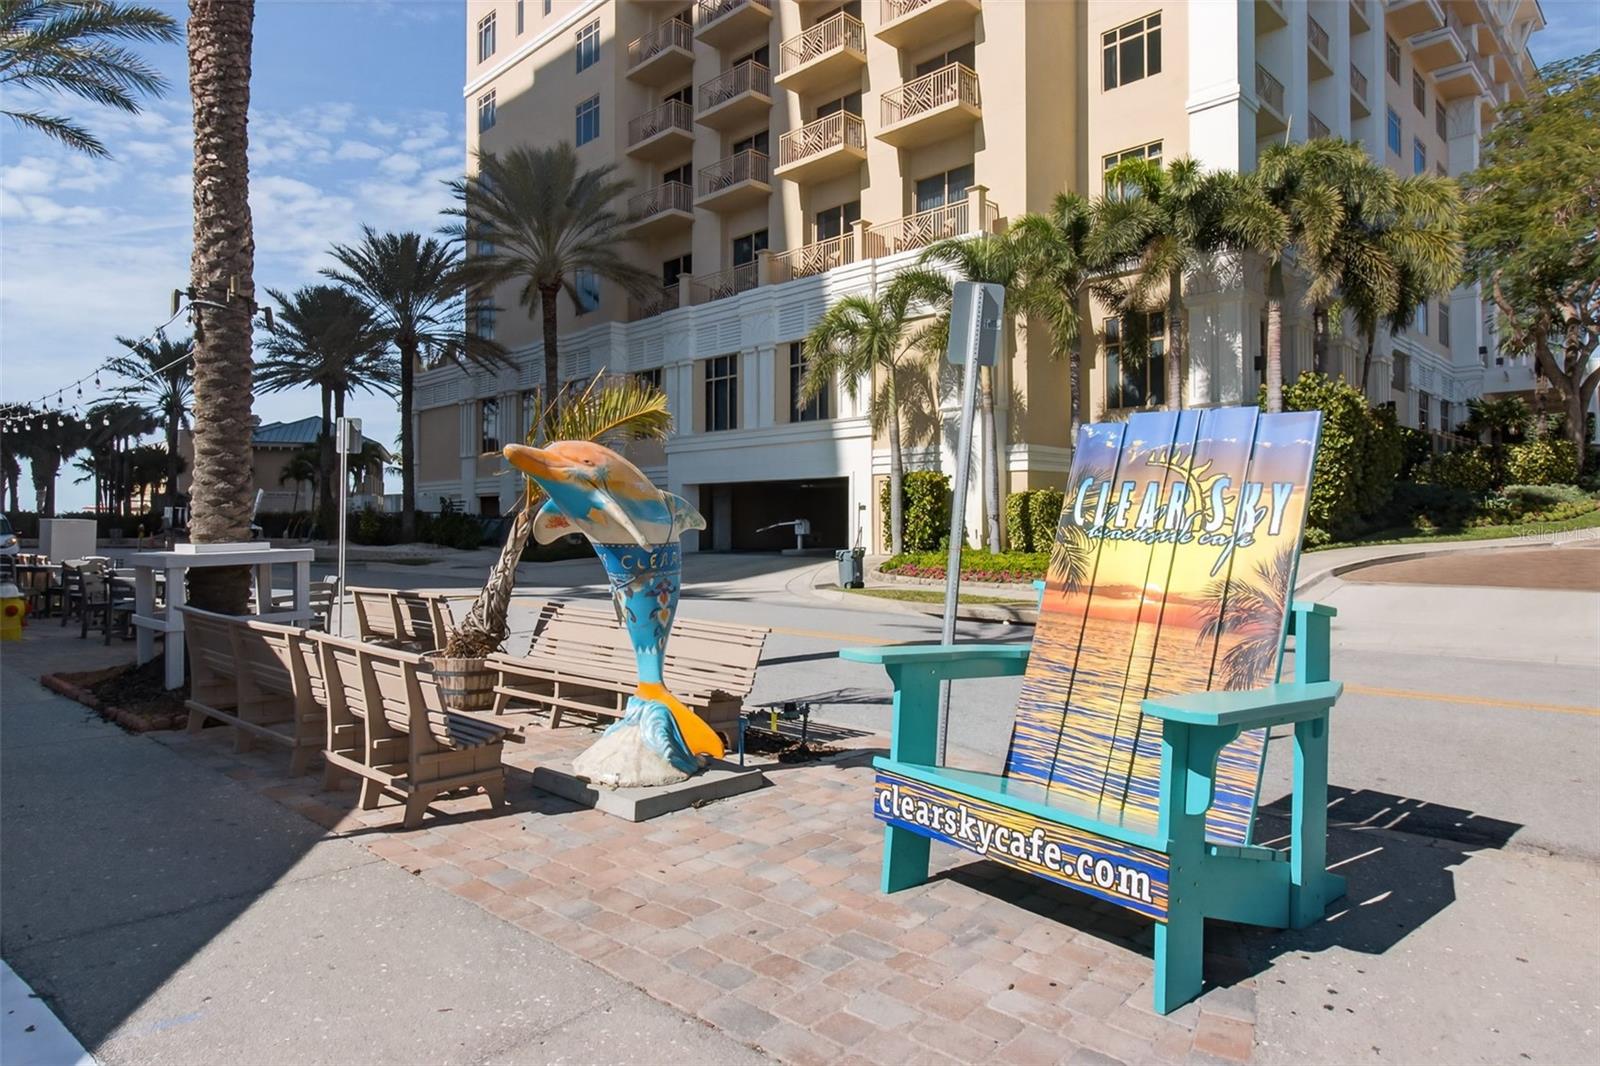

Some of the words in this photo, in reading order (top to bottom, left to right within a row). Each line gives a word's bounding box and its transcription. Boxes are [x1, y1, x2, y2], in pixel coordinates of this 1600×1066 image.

[1074, 477, 1191, 530] CLEAR
[1204, 475, 1293, 536] SKY
[1087, 504, 1202, 545] beachside
[1198, 506, 1267, 577] cafe
[879, 784, 1152, 903] clearskycafe.com
